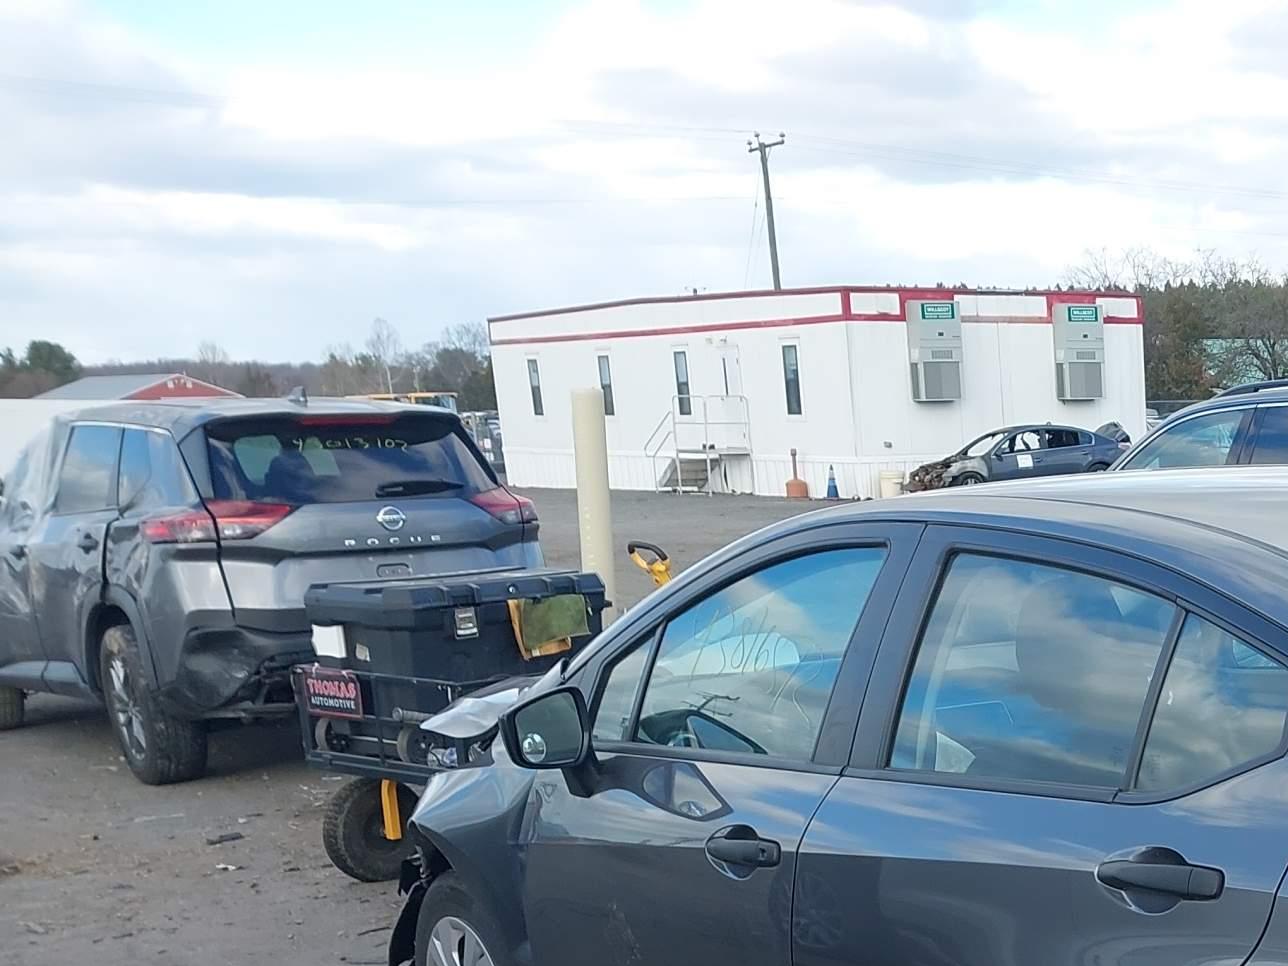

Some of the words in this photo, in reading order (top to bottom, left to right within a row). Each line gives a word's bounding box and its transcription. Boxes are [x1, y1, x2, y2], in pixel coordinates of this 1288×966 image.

[344, 535, 441, 546] ROGUE
[307, 678, 356, 699] THOMAS
[311, 695, 355, 709] AUTOMOTIVE
